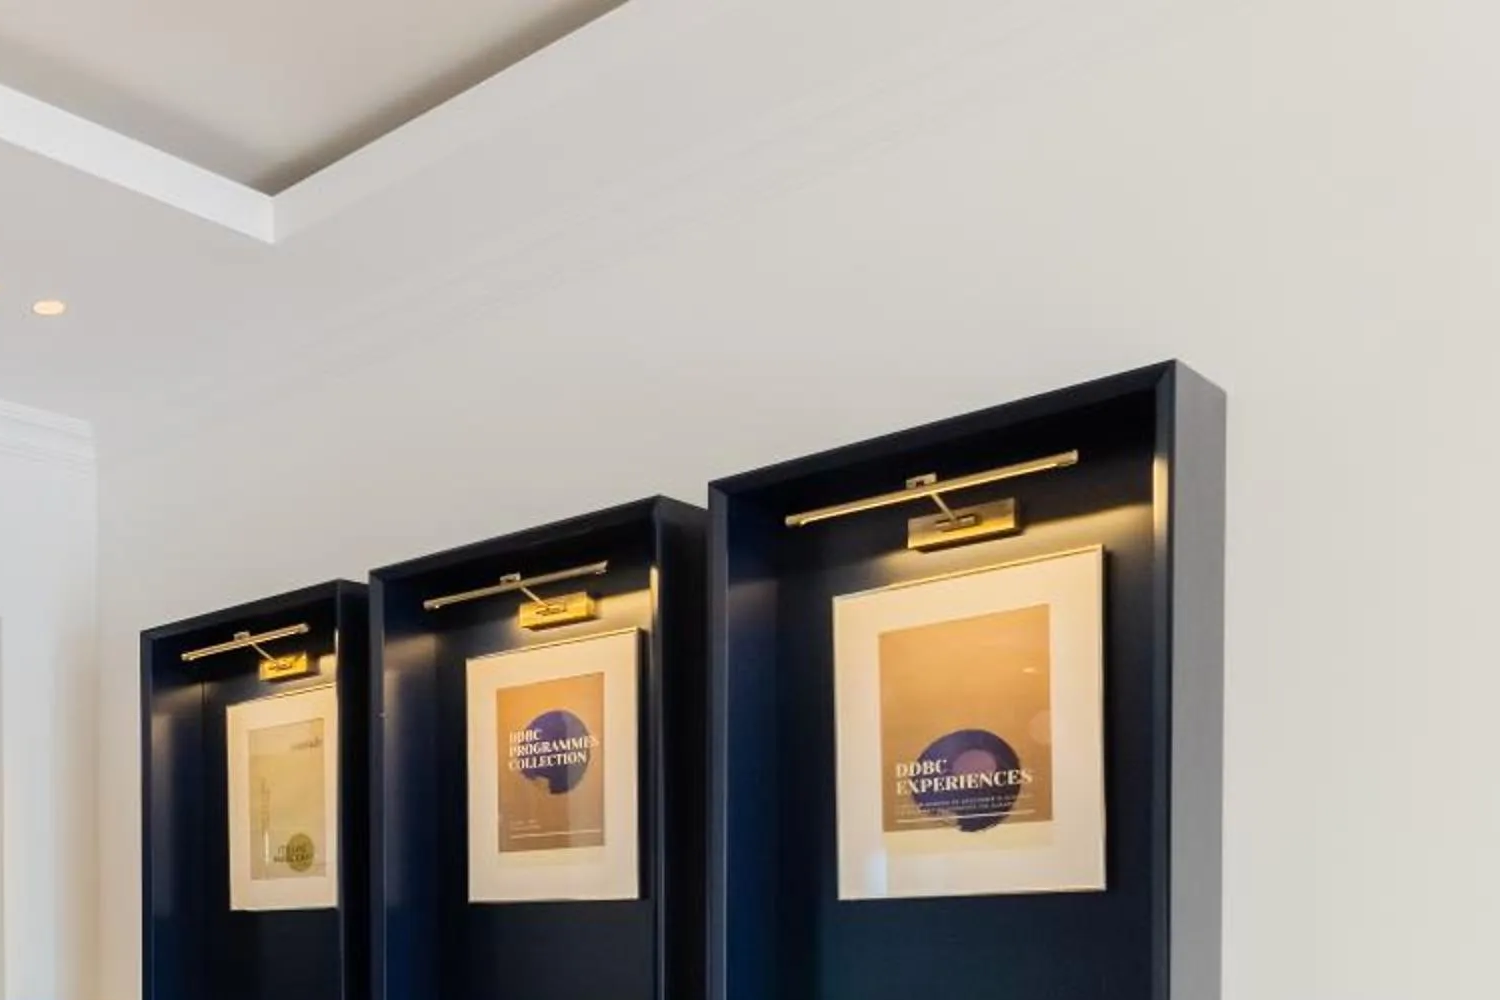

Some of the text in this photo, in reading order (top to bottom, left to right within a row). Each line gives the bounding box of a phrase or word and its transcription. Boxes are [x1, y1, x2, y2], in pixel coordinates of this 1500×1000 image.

[510, 736, 600, 757] PROGRAMMES
[509, 752, 587, 770] COLLECTION
[896, 759, 947, 777] DDBC
[896, 768, 1033, 795] EXPERIENCES
